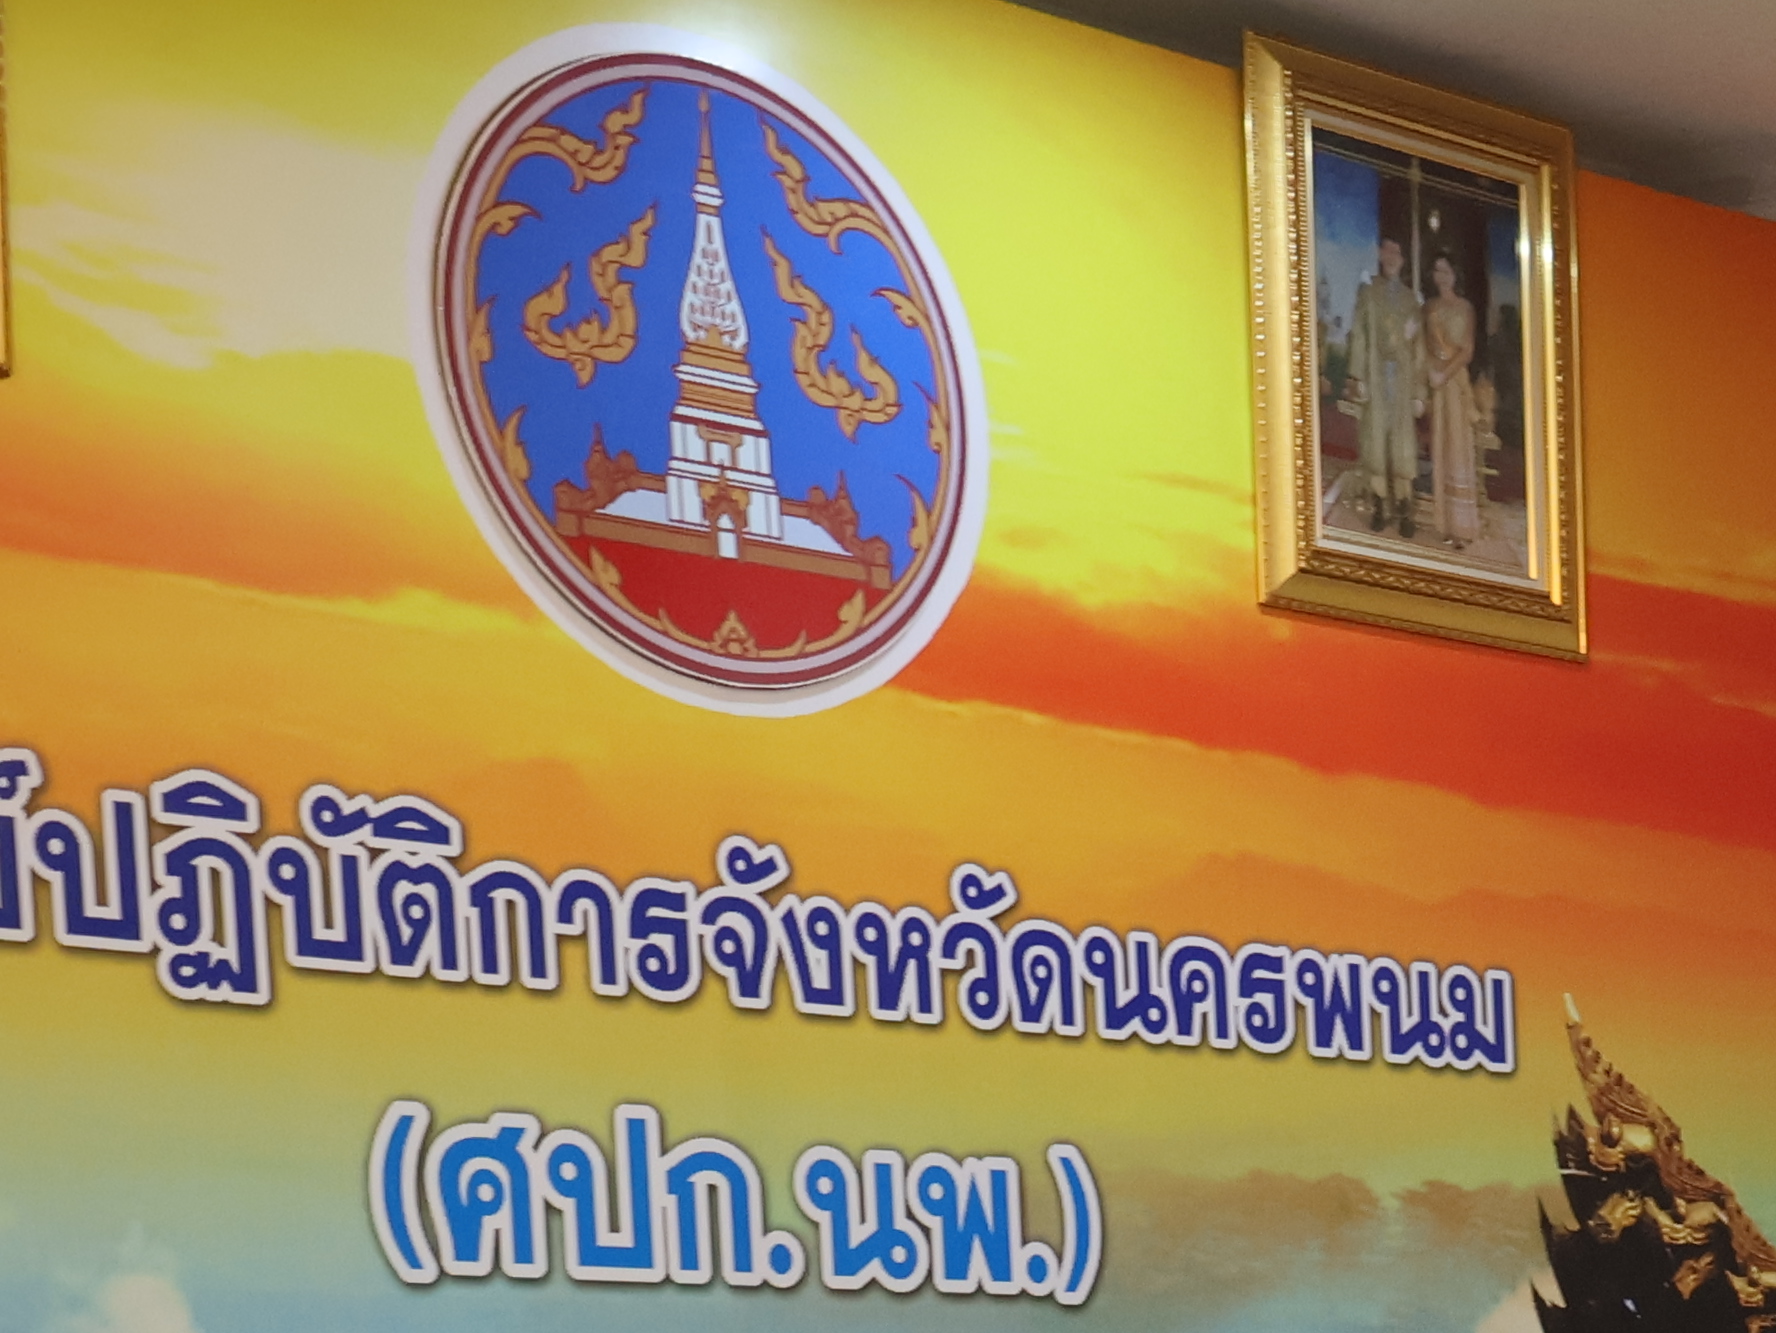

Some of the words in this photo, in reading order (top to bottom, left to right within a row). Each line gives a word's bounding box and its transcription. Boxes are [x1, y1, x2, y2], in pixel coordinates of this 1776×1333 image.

[0, 759, 1511, 1067] ์ปฏิบัติการจังหวัดนครพนม
[381, 1110, 1097, 1296] (ศปก.นพ.)
